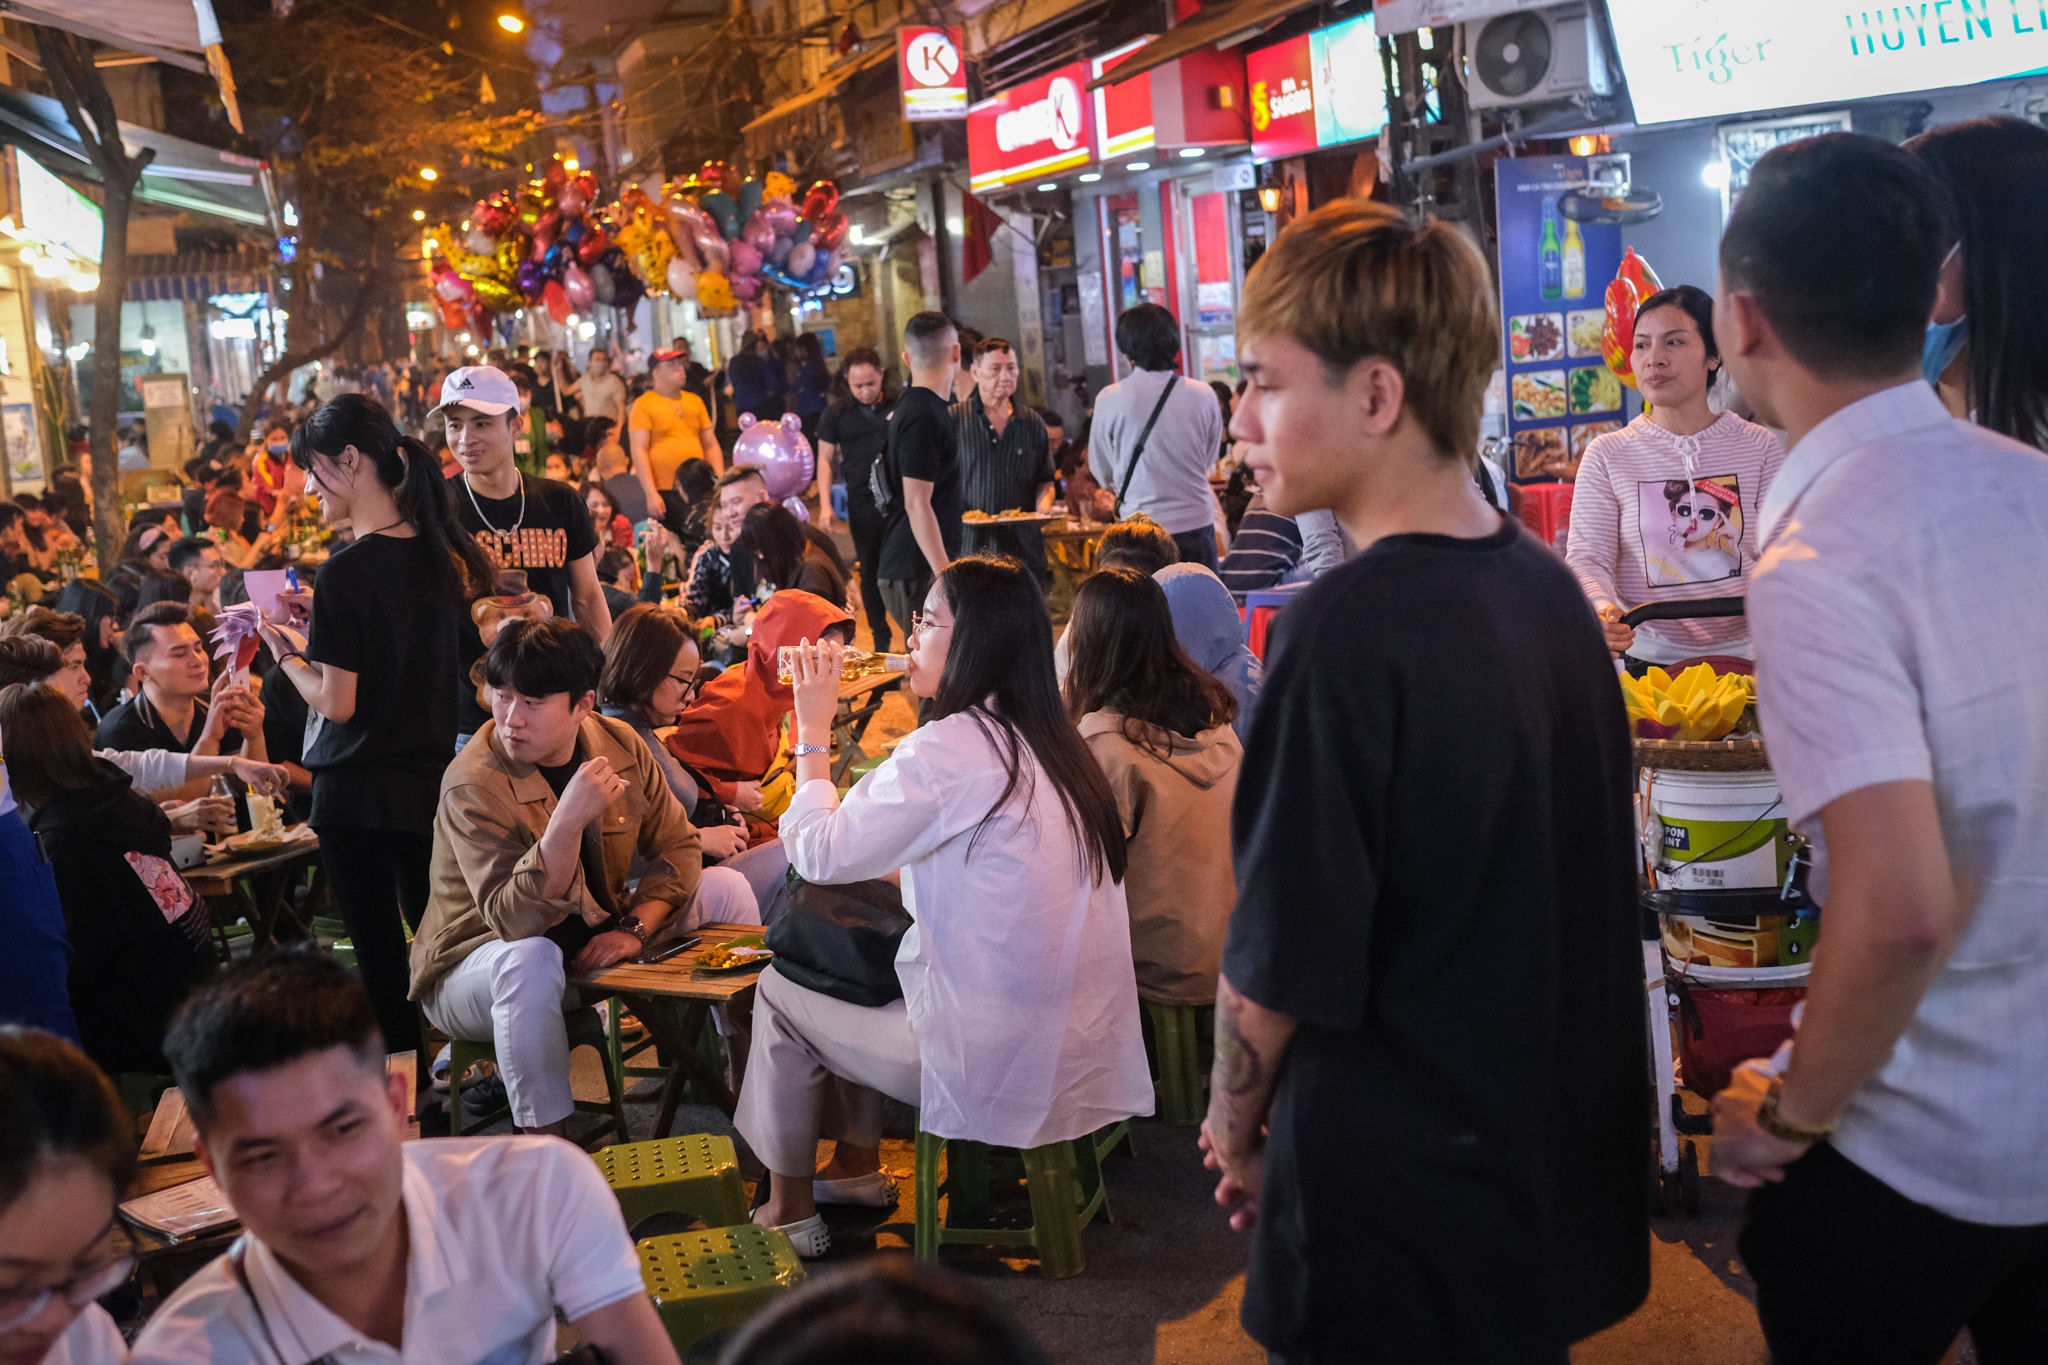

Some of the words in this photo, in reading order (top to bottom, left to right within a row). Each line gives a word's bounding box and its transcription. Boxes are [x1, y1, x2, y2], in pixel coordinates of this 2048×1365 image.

[1662, 32, 1772, 84] Tiger
[469, 528, 567, 569] SCHINO
[1665, 826, 1685, 839] PON
[1665, 836, 1681, 848] INT
